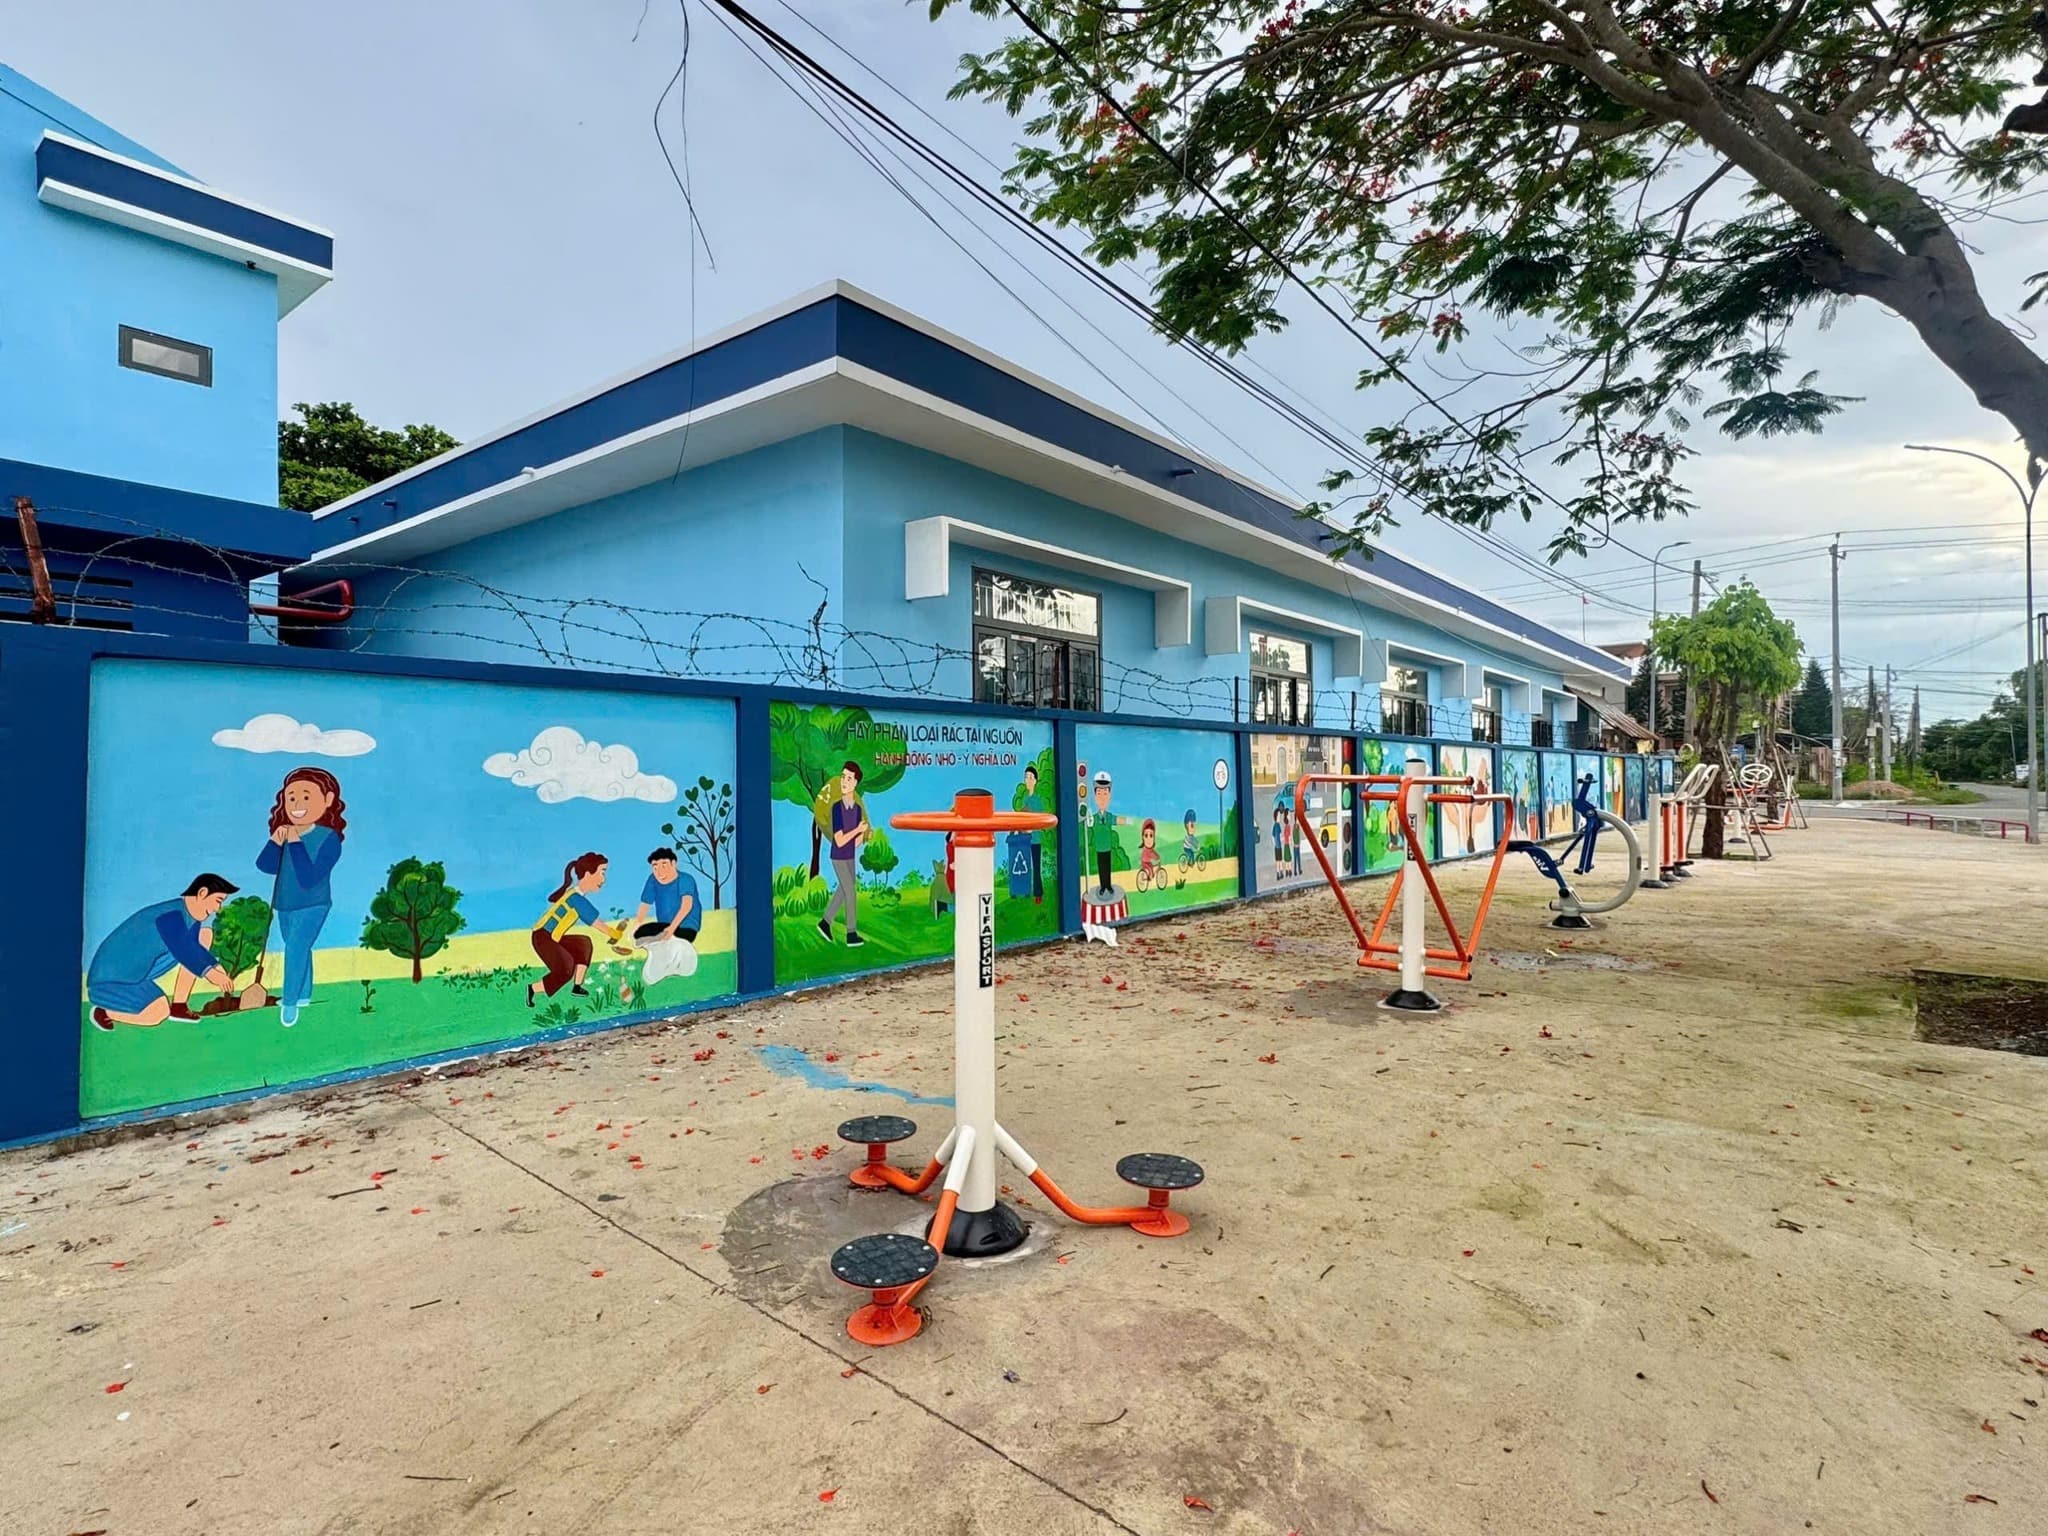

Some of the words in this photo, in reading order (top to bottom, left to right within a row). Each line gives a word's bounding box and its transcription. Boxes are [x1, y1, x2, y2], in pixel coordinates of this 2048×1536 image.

[911, 722, 939, 745] LOẠI
[941, 722, 964, 743] RÁC
[965, 724, 981, 745] TẠI
